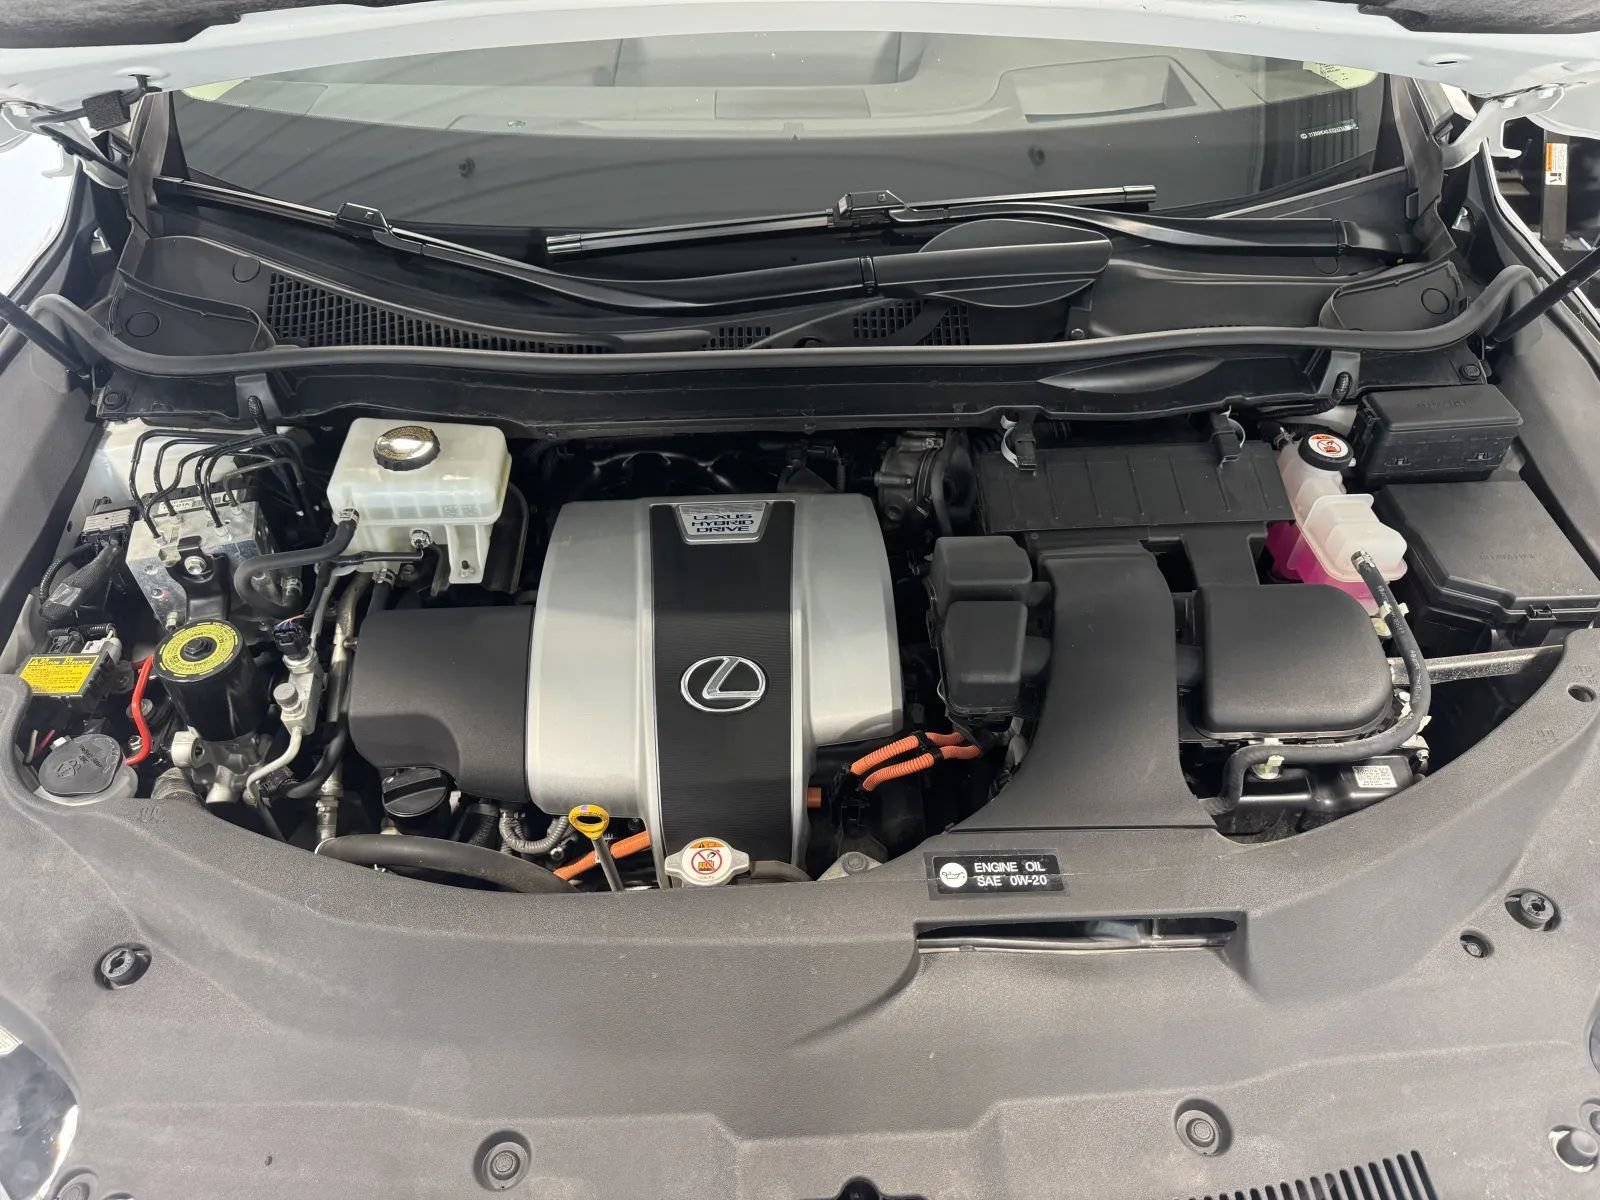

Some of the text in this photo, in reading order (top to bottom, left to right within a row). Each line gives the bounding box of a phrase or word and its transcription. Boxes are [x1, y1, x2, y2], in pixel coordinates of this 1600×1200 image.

[693, 513, 753, 521] LEXUS
[691, 519, 755, 527] HYBRID
[696, 525, 750, 533] DRIVE
[974, 861, 1046, 873] ENGINE OIL
[977, 874, 1048, 887] SAE 0W-20
